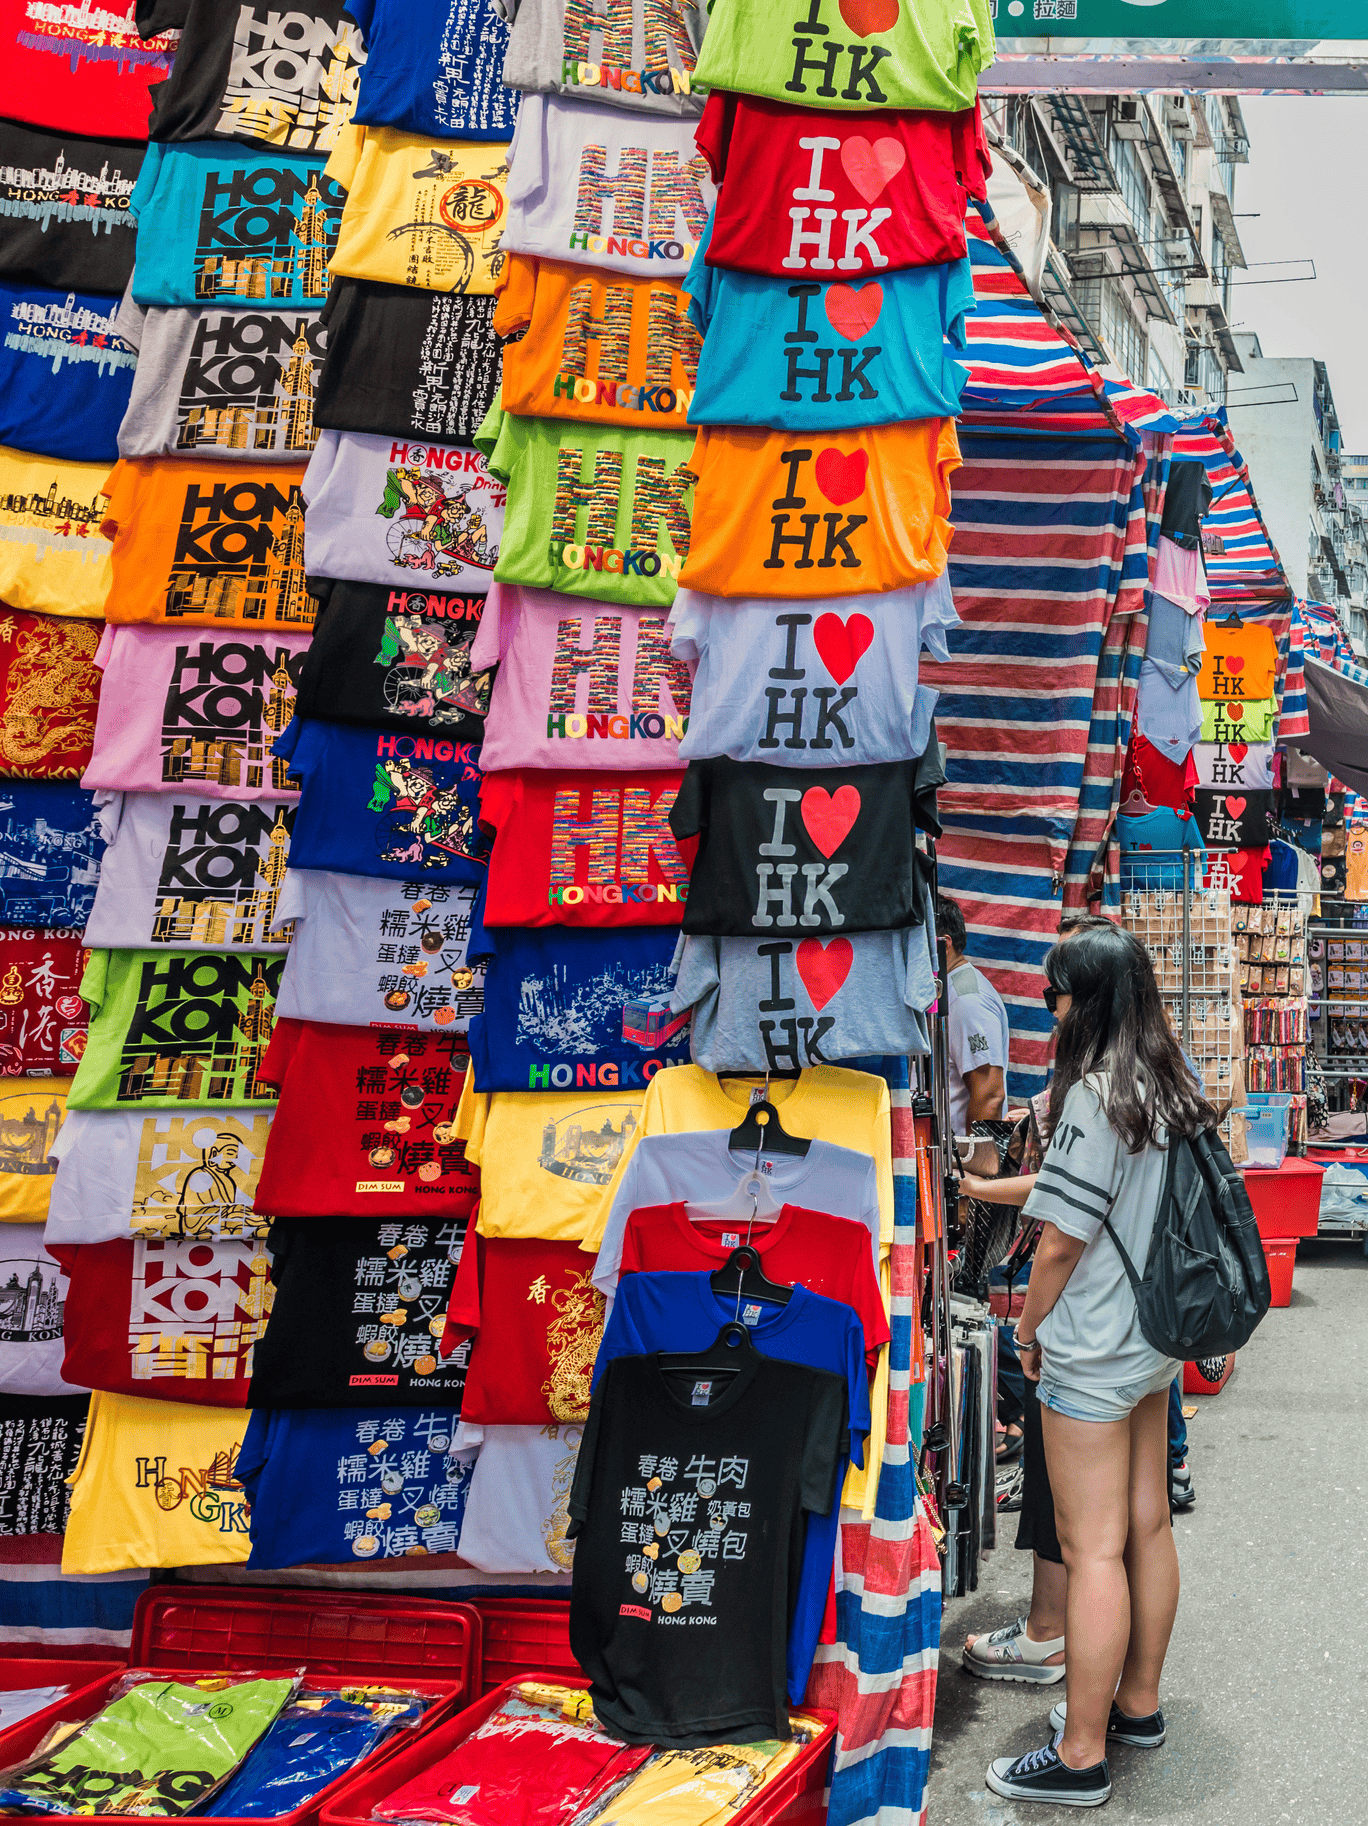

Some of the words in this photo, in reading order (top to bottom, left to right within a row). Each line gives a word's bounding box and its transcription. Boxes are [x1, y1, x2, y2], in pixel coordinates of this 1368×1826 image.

[34, 22, 89, 41] HONG
[793, 0, 830, 35] I
[785, 38, 892, 103] HK
[792, 136, 841, 202] I
[8, 187, 60, 202] HONG
[446, 185, 496, 221] 龍
[782, 207, 892, 270] HK
[784, 284, 821, 343] I
[18, 322, 72, 341] HONG
[780, 346, 882, 402] HK
[772, 449, 812, 510] I
[763, 513, 868, 569] HK
[768, 613, 812, 680] I
[1213, 655, 1224, 675] I
[1212, 677, 1245, 695] HK
[758, 687, 858, 749] HK
[1214, 702, 1225, 722] I
[1214, 724, 1245, 742] HK
[1213, 743, 1226, 762] I
[1211, 764, 1245, 784] HK
[759, 788, 802, 857] I
[1210, 795, 1226, 817] I
[1206, 819, 1243, 842] HK
[752, 863, 849, 926] HK
[757, 942, 796, 1012] I
[18, 951, 71, 1052] 香港
[759, 1016, 835, 1070] HK
[357, 1183, 378, 1191] DIM
[380, 1184, 402, 1192] SUM
[415, 1185, 446, 1194] HONG
[449, 1186, 479, 1195] KONG
[376, 1223, 428, 1248] 春卷
[354, 1257, 451, 1289] 糯米雞
[527, 1275, 551, 1304] 香
[351, 1376, 373, 1385] DIM
[375, 1376, 397, 1385] SUM
[410, 1378, 441, 1388] HONG
[356, 1418, 405, 1444] 春卷
[337, 1450, 431, 1484] 糯米雞
[638, 1454, 679, 1481] 春卷
[684, 1455, 749, 1489] 牛肉
[620, 1486, 699, 1523] 糯米雞
[662, 1529, 748, 1560] 叉燒包
[648, 1569, 716, 1606] 燒賣
[621, 1606, 637, 1616] DIM
[658, 1616, 687, 1625] HONG
[689, 1616, 717, 1625] KONG
